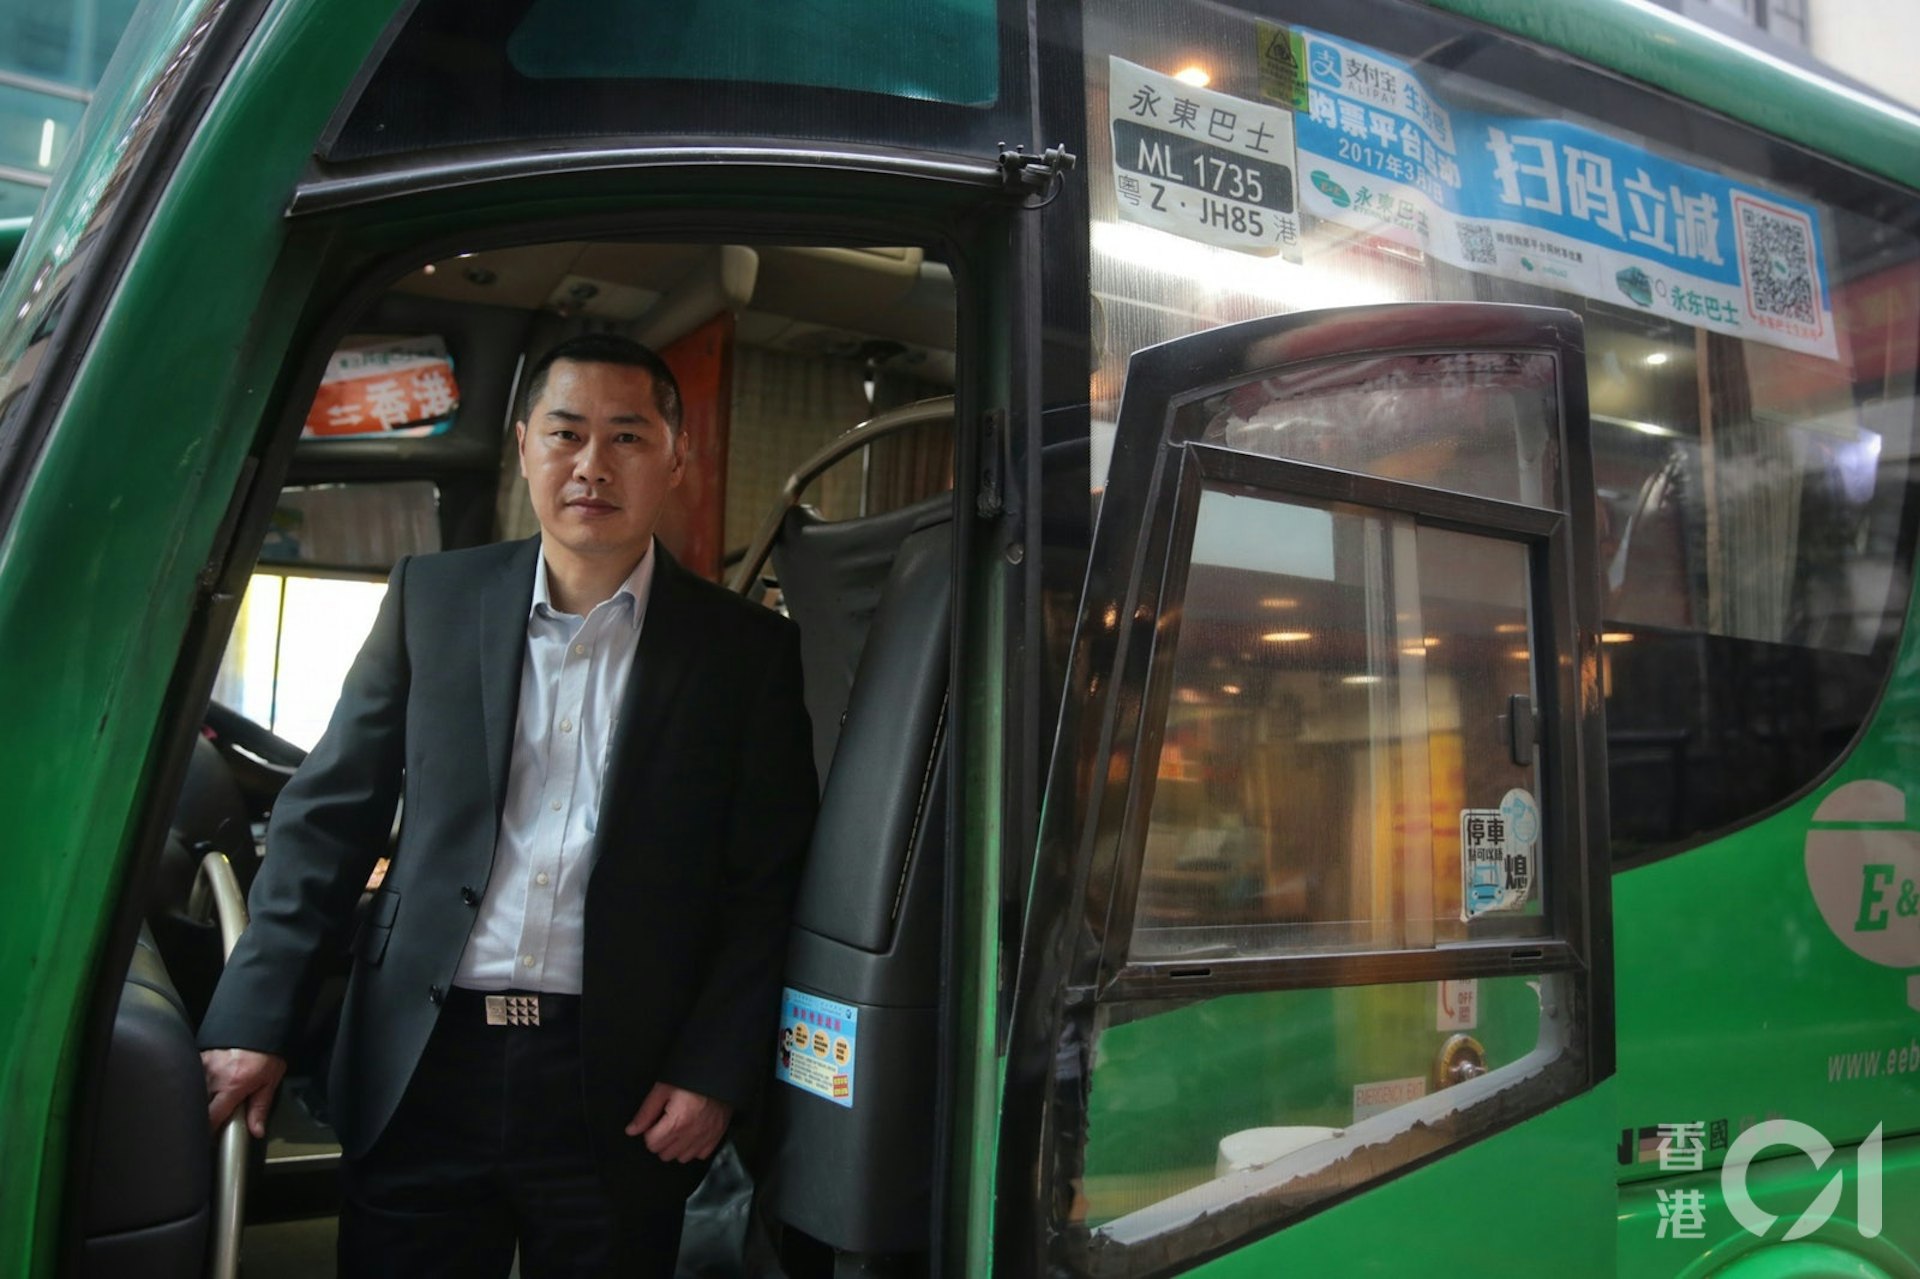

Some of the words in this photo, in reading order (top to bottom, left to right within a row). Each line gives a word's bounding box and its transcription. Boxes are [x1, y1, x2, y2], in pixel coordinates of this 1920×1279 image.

[1345, 57, 1397, 94] 支付宝
[1128, 84, 1275, 154] 永東巴士
[1137, 137, 1184, 182] ML
[1193, 154, 1264, 204] 1735
[1486, 126, 1725, 267] 扫码立减
[1670, 284, 1741, 326] 永东巴士
[1467, 818, 1505, 847] 停車
[1504, 854, 1528, 891] 熄
[1457, 990, 1474, 1005] OFF
[1356, 1084, 1402, 1107] EMERGENCY
[1406, 1080, 1425, 1101] EXIT
